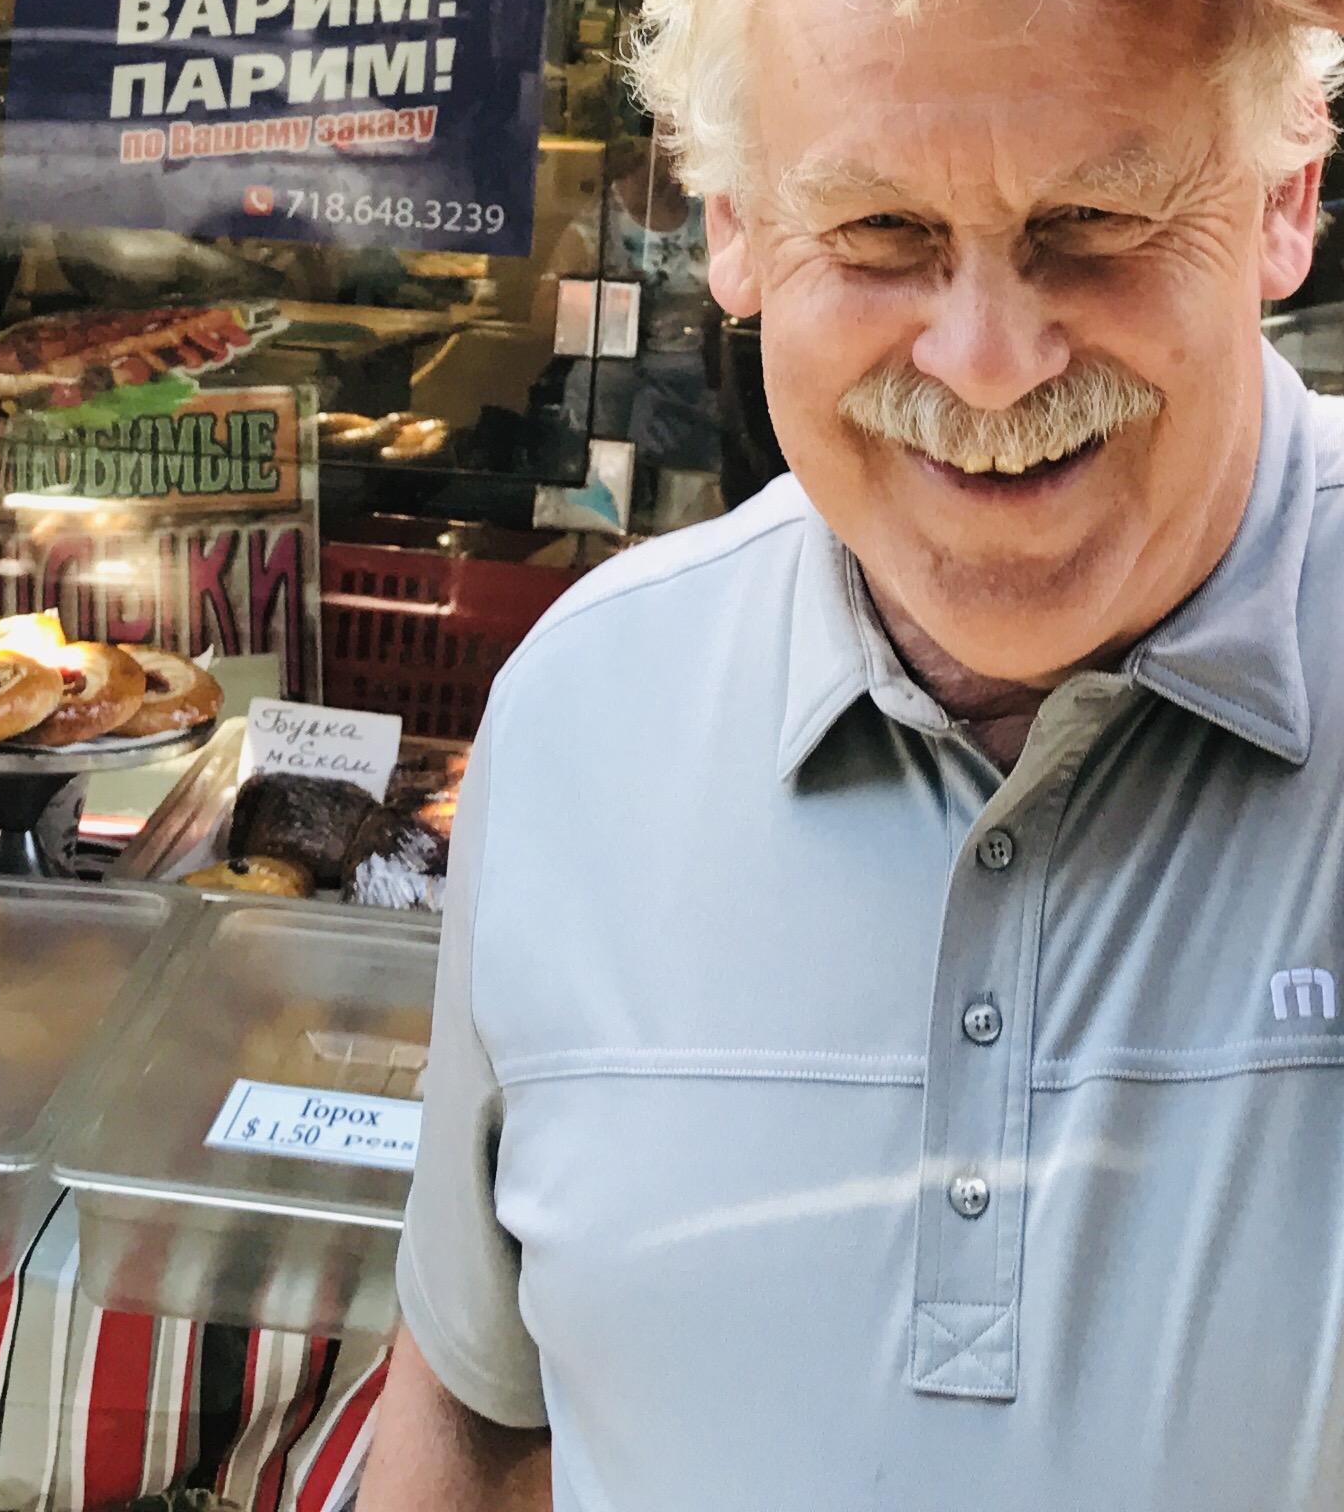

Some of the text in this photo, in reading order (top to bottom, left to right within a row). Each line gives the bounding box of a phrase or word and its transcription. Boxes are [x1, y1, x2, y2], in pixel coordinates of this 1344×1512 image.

[109, 38, 457, 118] ПАРИМ!
[121, 106, 437, 162] по Вашему заказу
[287, 190, 505, 233] 718.648.3239
[299, 1097, 384, 1128] Горох
